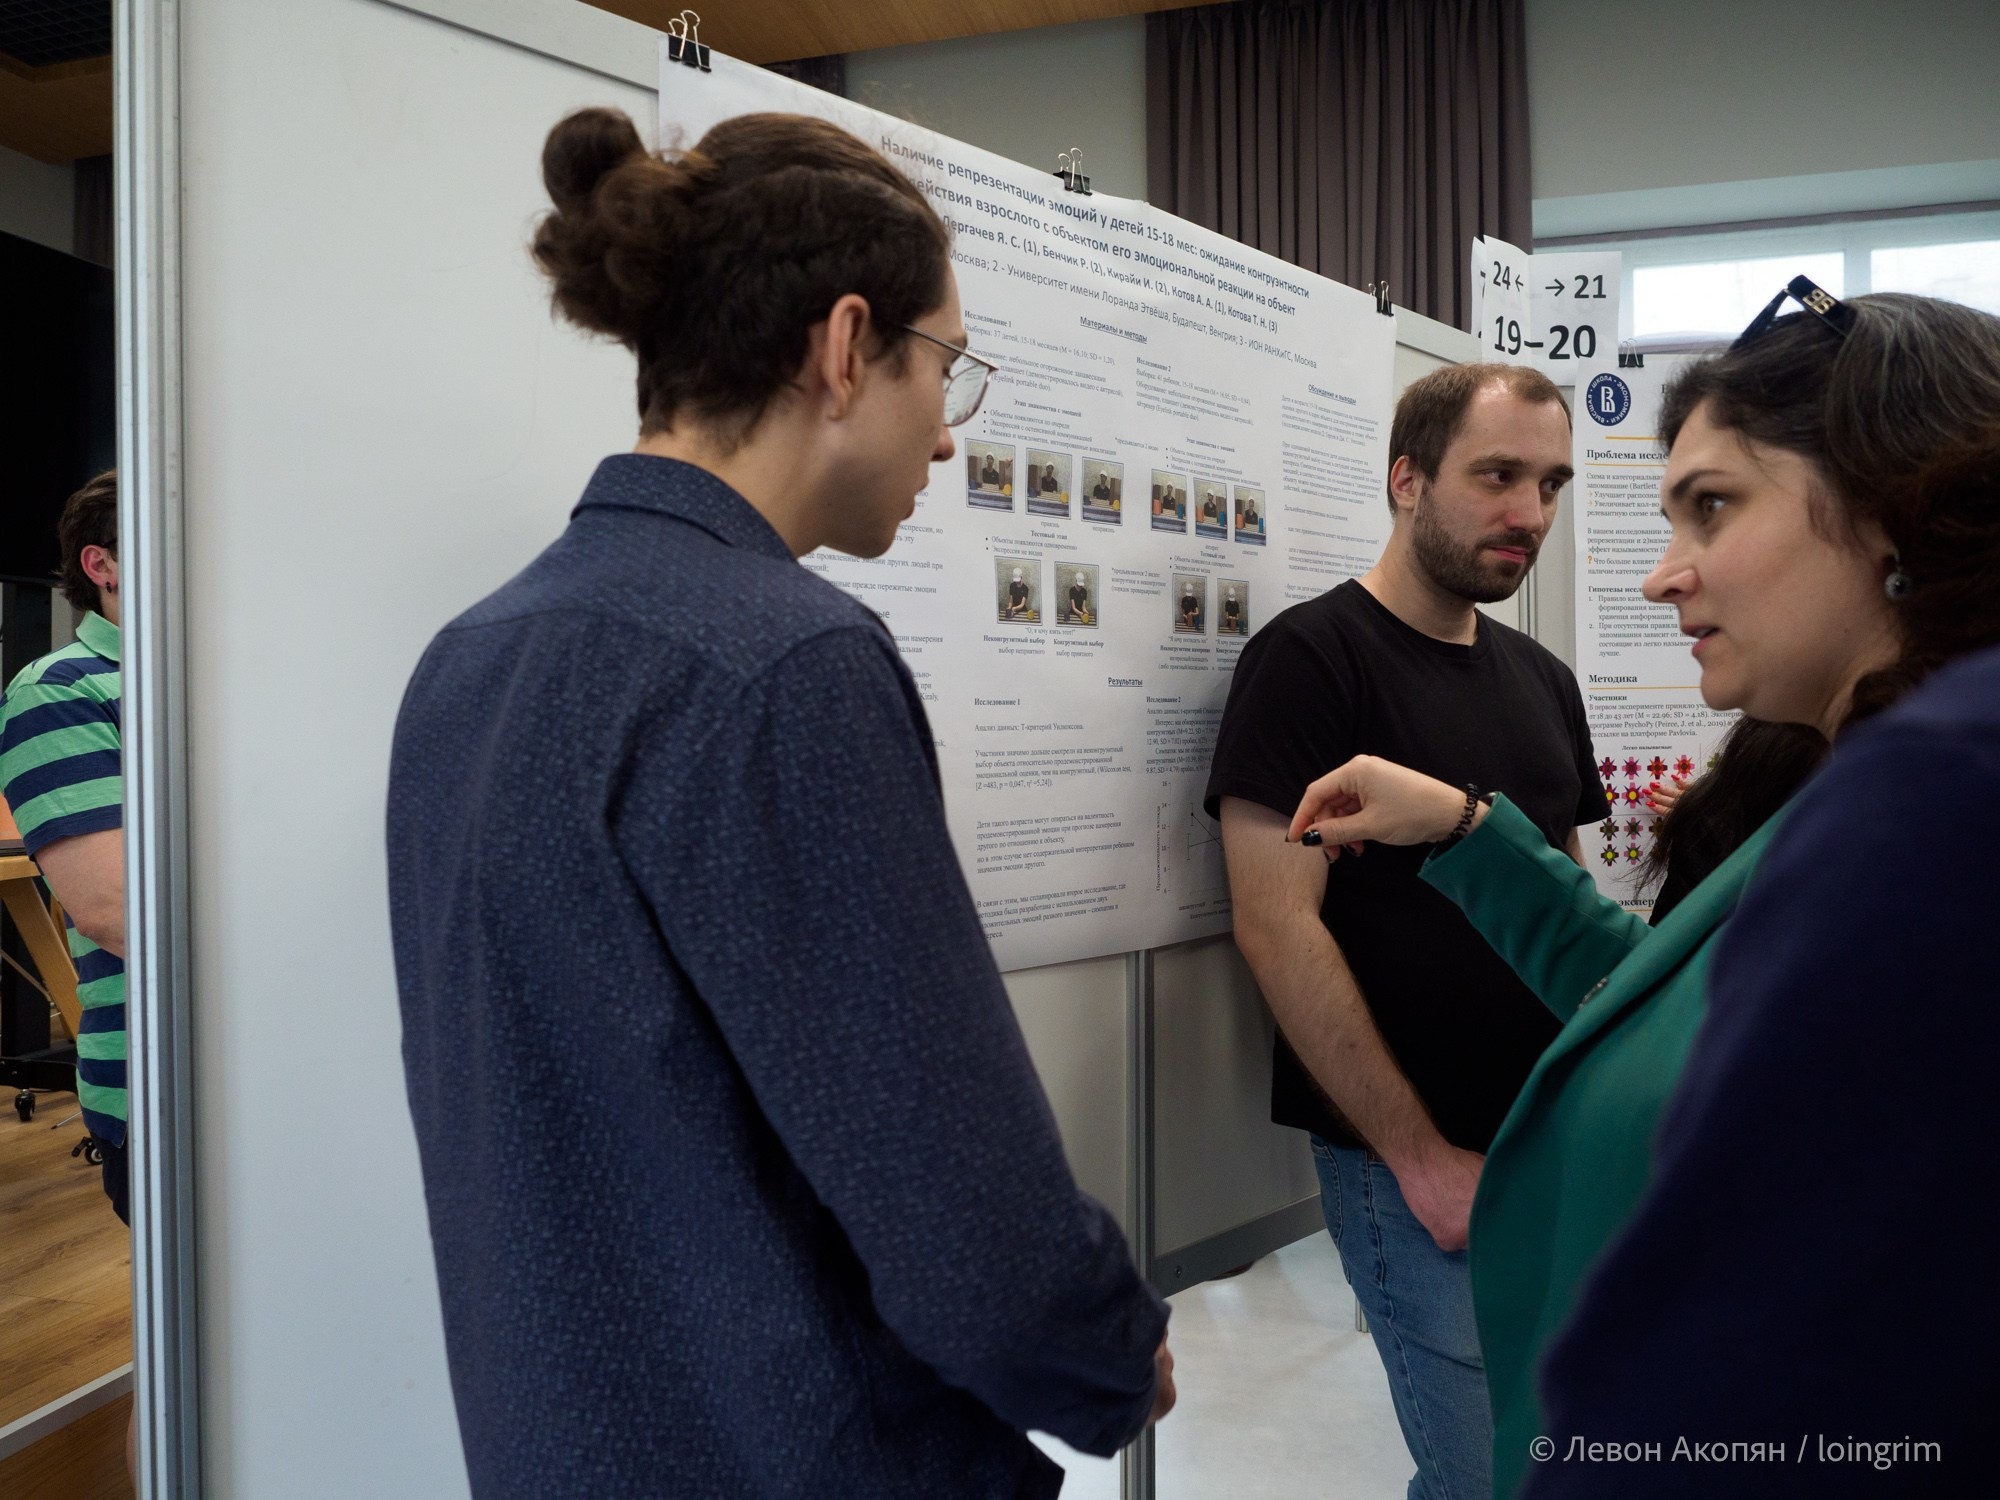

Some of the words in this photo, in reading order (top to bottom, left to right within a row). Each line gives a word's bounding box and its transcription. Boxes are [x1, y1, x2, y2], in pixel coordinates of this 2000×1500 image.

[882, 136, 944, 170] Наличие
[948, 162, 1045, 207] репрезентации
[1048, 200, 1097, 222] эмоций
[1101, 214, 1107, 228] у
[1110, 218, 1144, 236] детей
[1147, 226, 1174, 246] 15-18
[1176, 240, 1197, 256] мес:
[1200, 248, 1245, 274] ожидание
[1248, 266, 1309, 298] конгруэнтности
[976, 199, 1040, 230] взрослого
[1044, 222, 1050, 233] с
[1052, 226, 1109, 253] объектом
[1112, 245, 1131, 259] его
[1134, 250, 1215, 286] эмоциональной
[1218, 279, 1254, 300] реакции
[1256, 294, 1266, 305] на
[1268, 298, 1296, 316] объект
[1493, 261, 1510, 290] 24
[997, 232, 1008, 245] Я.
[1011, 236, 1020, 249] С.
[1024, 238, 1040, 256] (1),
[1043, 246, 1079, 266] Бенчик
[1081, 258, 1089, 270] Р.
[1091, 260, 1106, 277] (2),
[1107, 267, 1142, 286] Кирайи
[1144, 278, 1153, 290] И.
[1156, 280, 1170, 296] (2),
[1172, 286, 1195, 303] Котов
[1196, 295, 1204, 306] А.
[1206, 298, 1213, 309] А.
[1215, 300, 1226, 316] (1),
[1228, 306, 1251, 323] Котова
[1253, 314, 1259, 325] Т.
[1260, 317, 1267, 329] Н.
[1269, 320, 1278, 334] (3)
[1574, 274, 1606, 299] 21
[965, 310, 1007, 326] Исследование
[993, 260, 998, 272] 2
[1007, 264, 1068, 291] Университет
[1070, 284, 1100, 300] имени
[1102, 291, 1139, 311] Лоранда
[1140, 302, 1170, 322] Этвёша,
[1173, 312, 1208, 335] Будапешт,
[1210, 325, 1238, 345] Венгрия;
[1249, 339, 1263, 352] ИОН
[1295, 353, 1317, 369] Москва
[964, 324, 993, 336] Выборка:
[1080, 316, 1118, 333] Материалы
[1124, 330, 1147, 342] методы
[1016, 378, 1037, 388] portable
[1592, 376, 1612, 388] ШКОЛА
[1586, 450, 1636, 460] Проблема
[1594, 492, 1626, 500] Улучшает
[887, 558, 909, 568] других
[910, 559, 930, 569] людей
[932, 561, 943, 570] при
[852, 581, 875, 590] прежде
[877, 583, 912, 593] пережитые
[914, 585, 936, 594] эмоции
[1588, 586, 1623, 594] Гипотезы
[1598, 604, 1647, 612] формирования
[1599, 622, 1612, 630] При
[910, 635, 943, 644] намерения
[1108, 677, 1143, 686] Результаты
[1588, 675, 1638, 684] Методика
[974, 698, 1016, 706] Исследование
[1589, 694, 1627, 702] Участники
[997, 724, 1020, 732] данных:
[1624, 721, 1655, 729] PsychoPy
[1707, 720, 1726, 728] 2019)
